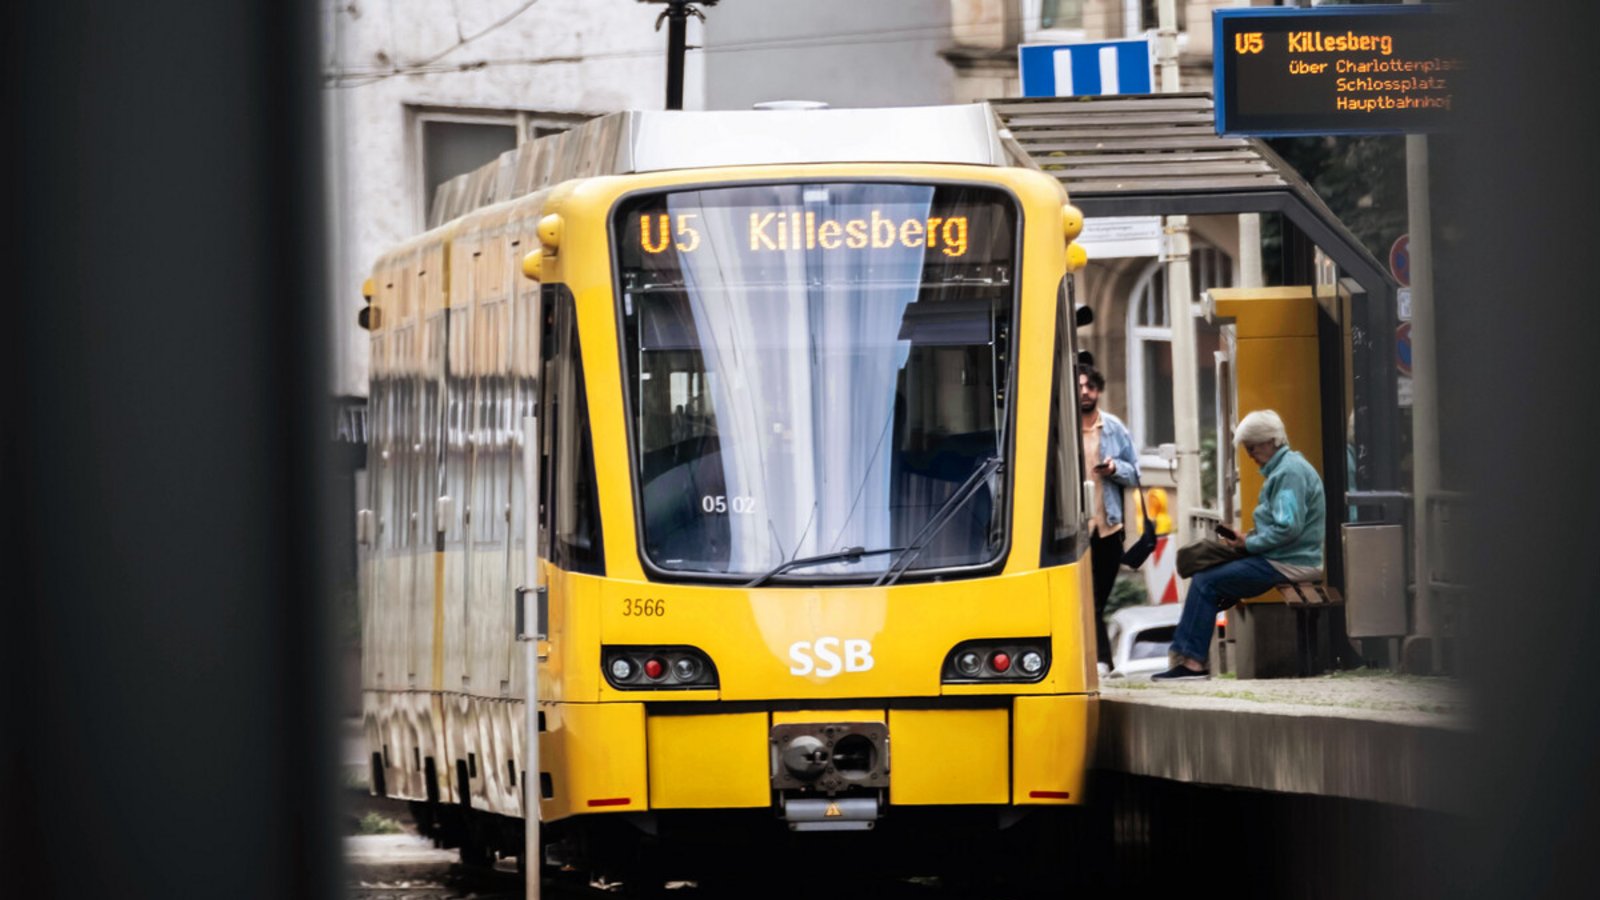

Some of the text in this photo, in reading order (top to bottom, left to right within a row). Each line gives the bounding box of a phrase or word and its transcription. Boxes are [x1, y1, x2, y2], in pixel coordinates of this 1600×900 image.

[1235, 31, 1393, 56] U5 Killesberg
[1289, 60, 1328, 74] über
[1336, 76, 1446, 93] Schlossplatz
[640, 211, 969, 257] U5 Killesberg
[702, 495, 755, 514] 05 02
[622, 597, 665, 617] 3566
[789, 637, 874, 677] SSB
